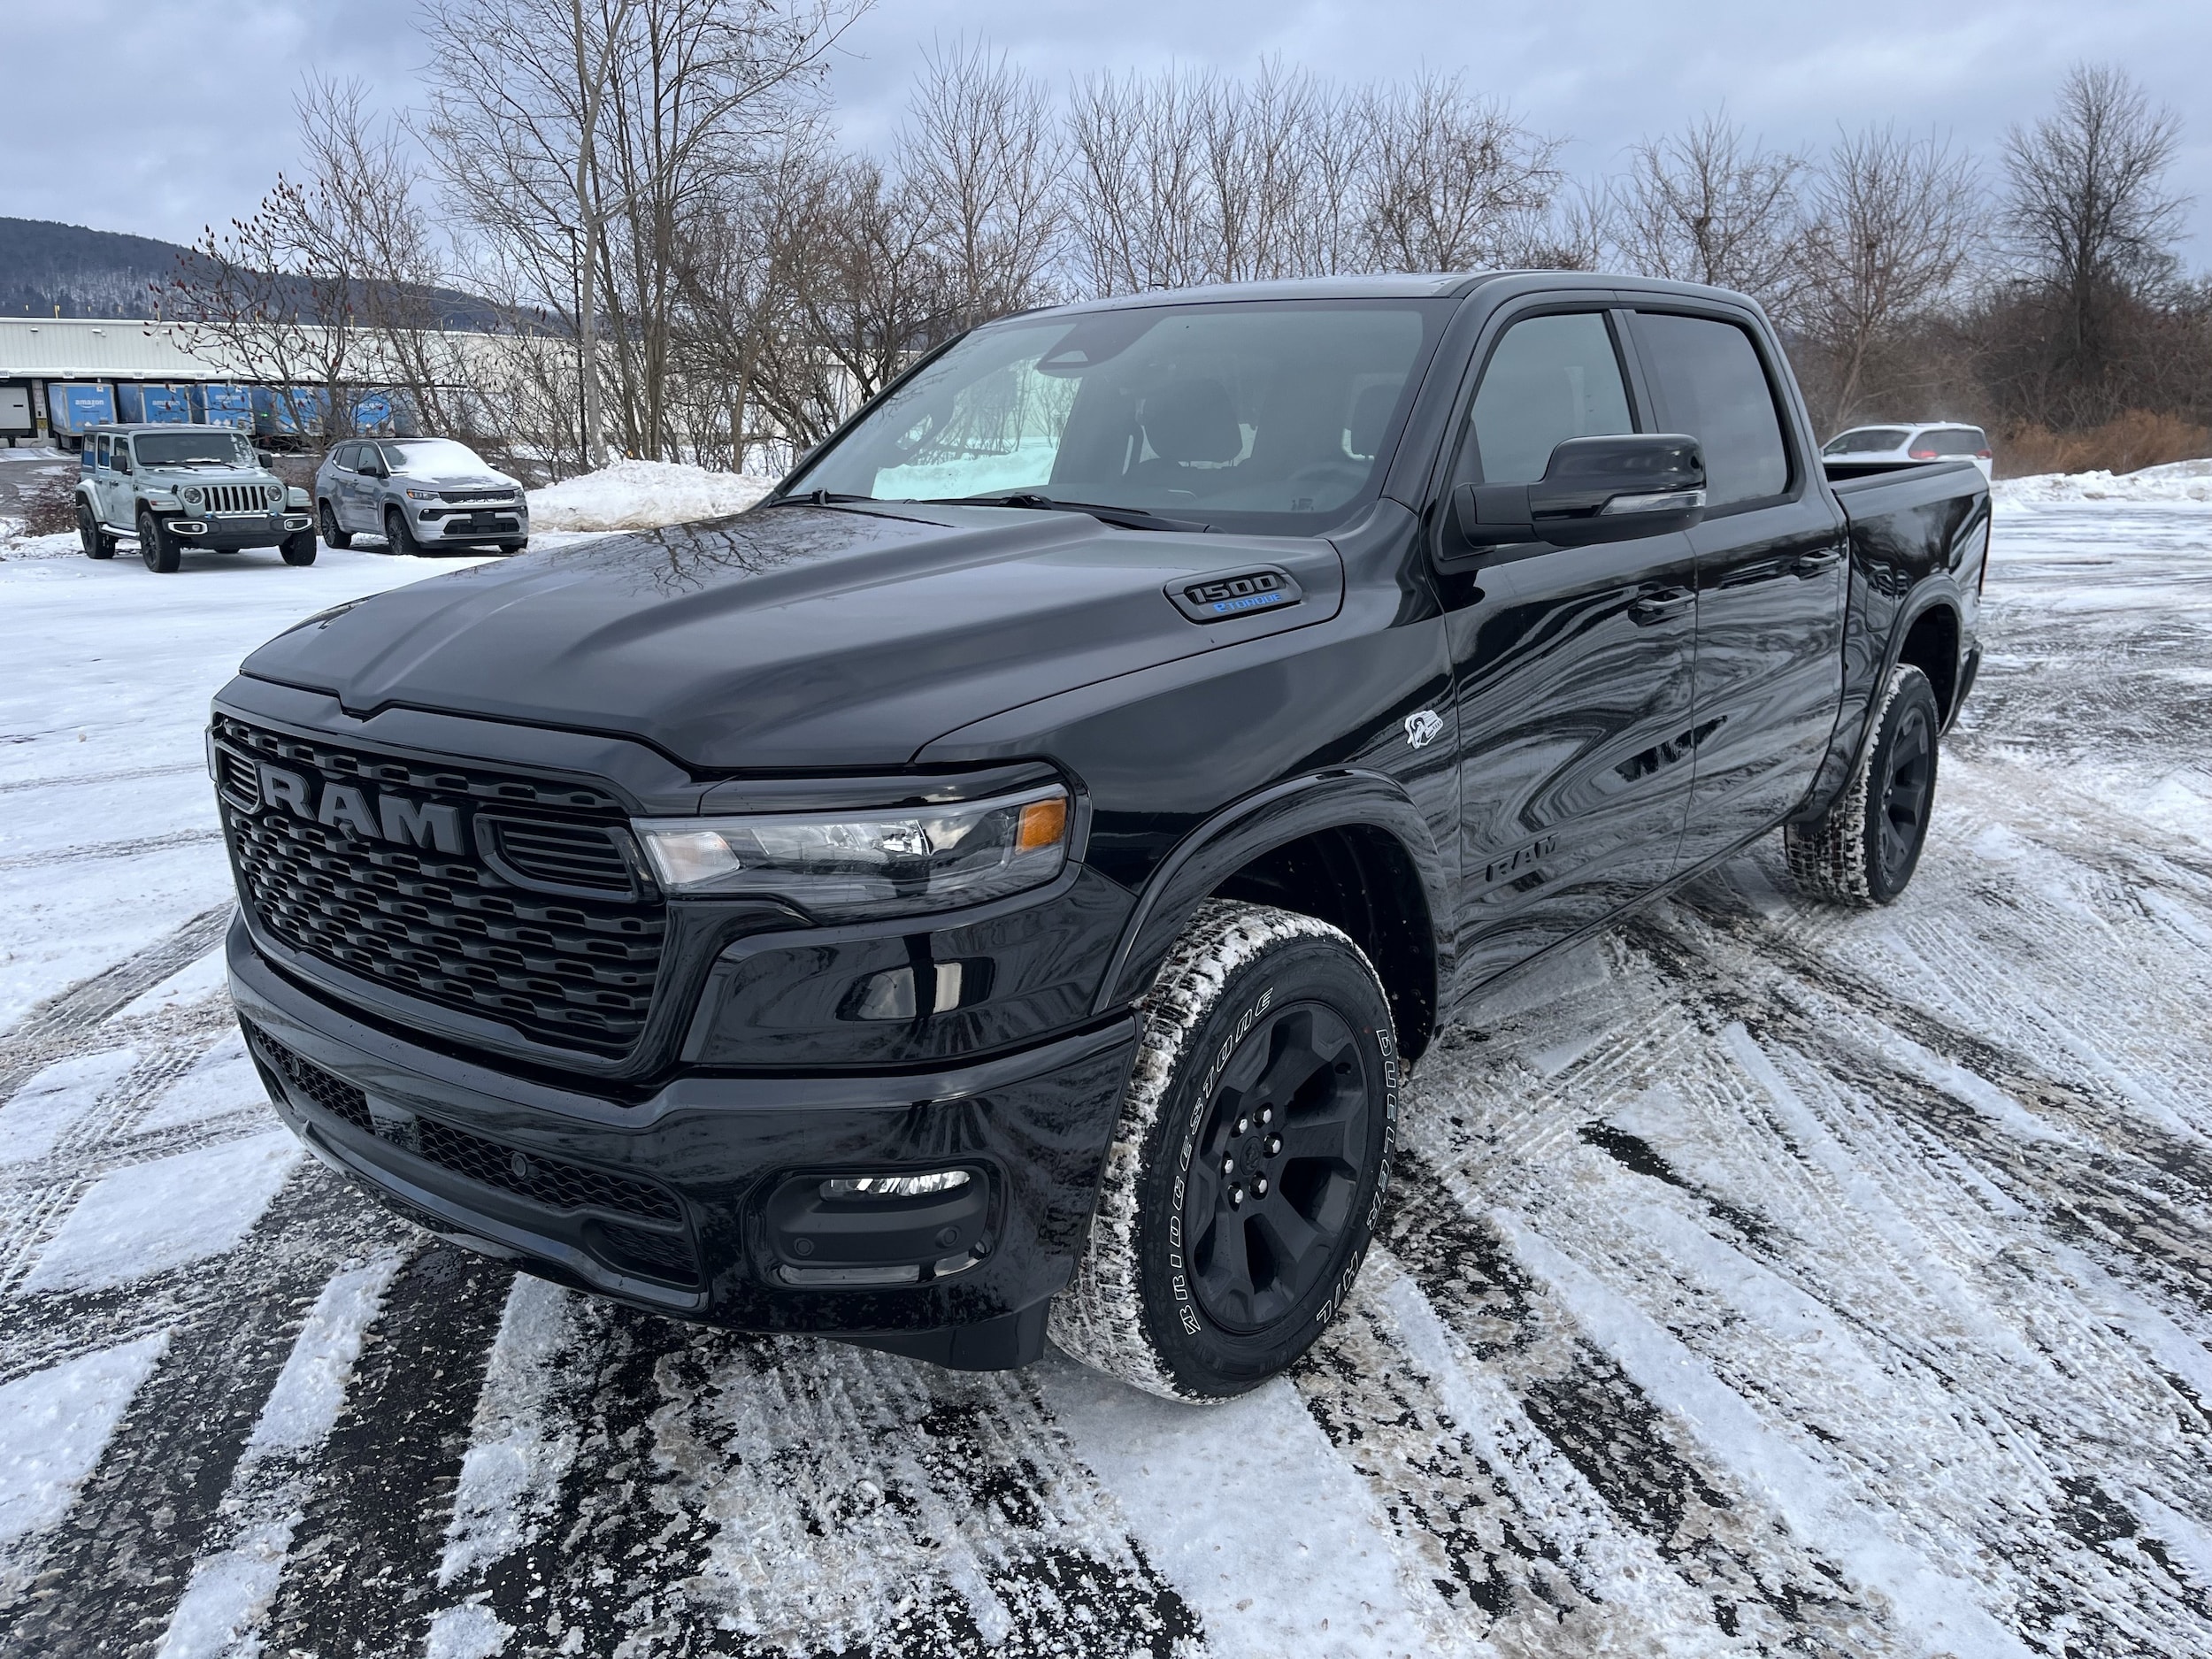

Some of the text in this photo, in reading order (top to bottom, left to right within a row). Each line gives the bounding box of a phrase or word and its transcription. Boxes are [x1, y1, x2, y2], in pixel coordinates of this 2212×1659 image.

[1187, 575, 1279, 604] 1500
[260, 762, 465, 856] RAM
[1486, 832, 1562, 882] RAM
[1168, 987, 1273, 1335] BRIDGESTONE
[1366, 1029, 1397, 1231] DUELER
